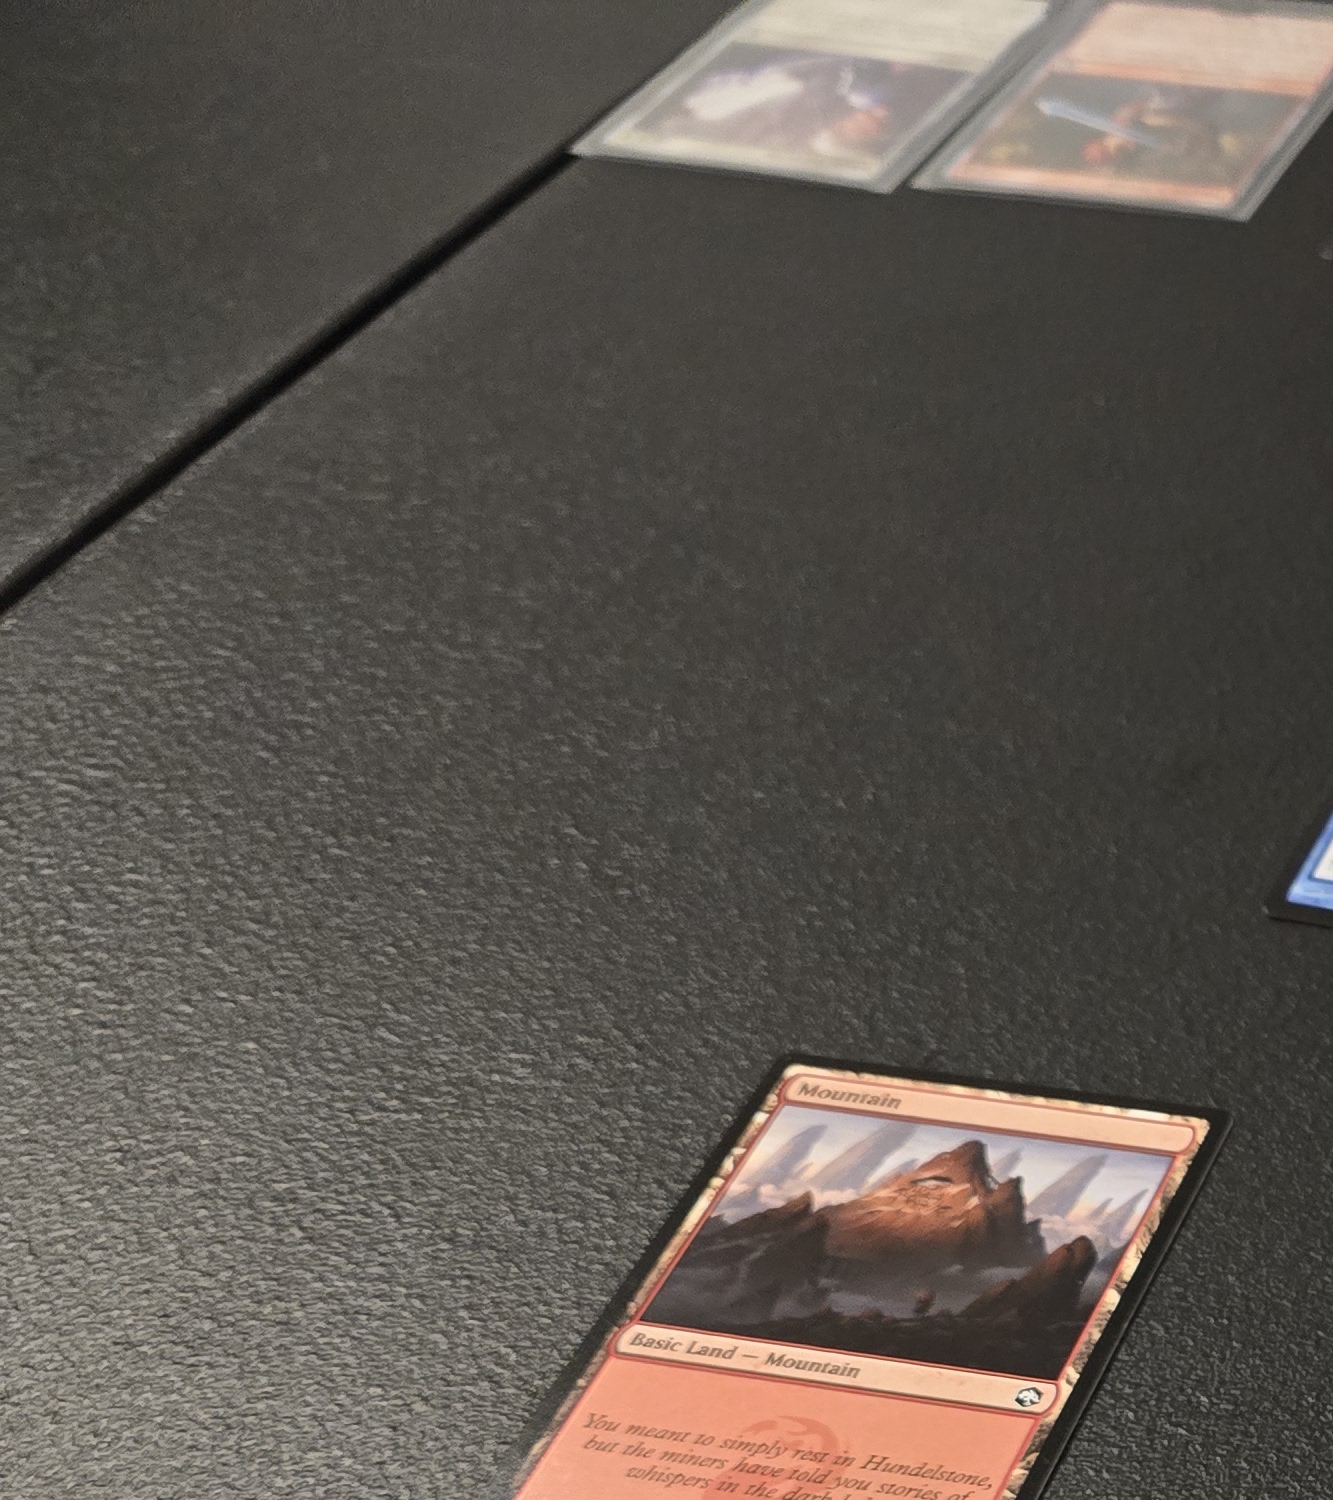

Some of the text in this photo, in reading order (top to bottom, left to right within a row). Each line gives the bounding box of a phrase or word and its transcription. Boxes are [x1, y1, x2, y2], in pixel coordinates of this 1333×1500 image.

[794, 1082, 906, 1109] Mountain
[629, 1332, 863, 1378] Basic Land Mountain
[581, 1412, 998, 1490] You meant to simply rest in Hundelstone,
[622, 1463, 714, 1491] whispers
[714, 1477, 742, 1493] in
[743, 1481, 780, 1499] the
